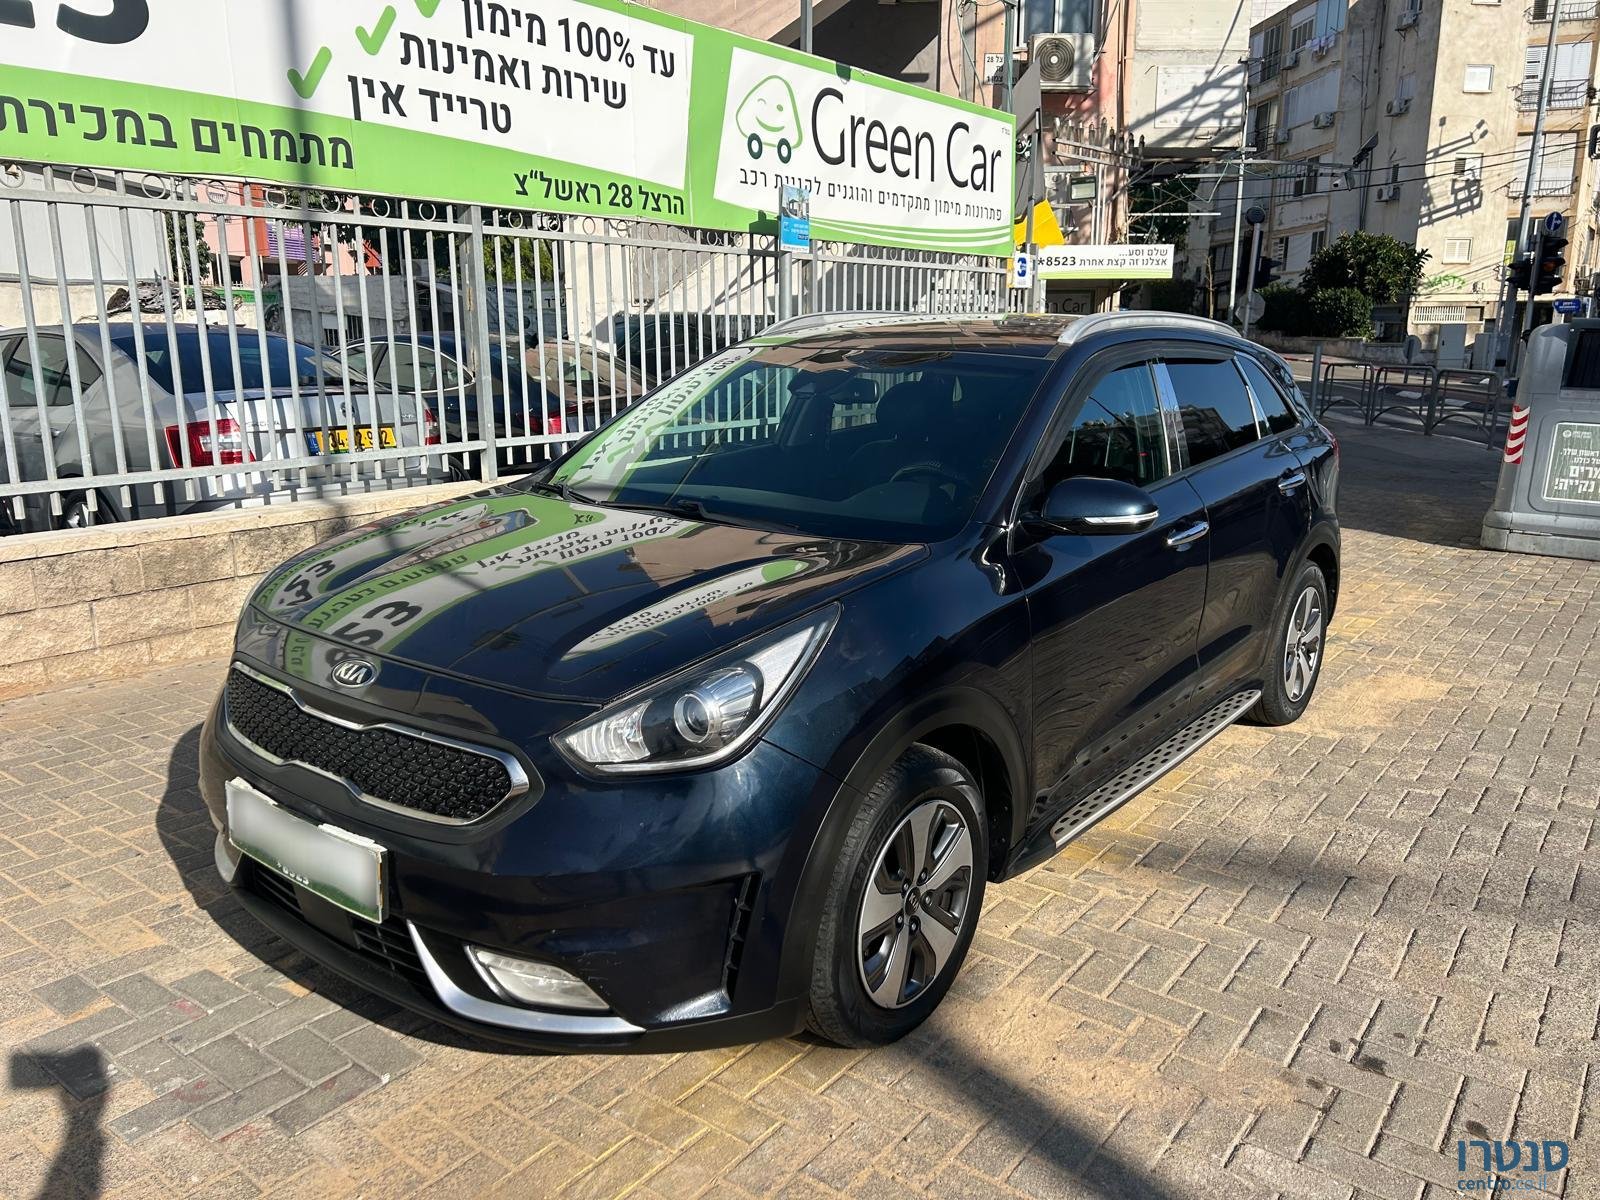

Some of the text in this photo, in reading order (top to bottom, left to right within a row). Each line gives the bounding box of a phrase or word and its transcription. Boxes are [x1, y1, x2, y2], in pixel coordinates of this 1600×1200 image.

[461, 0, 675, 78] עד 100% מימון
[400, 31, 627, 109] שירות ואמינות
[347, 75, 512, 134] טרייד אין
[0, 95, 354, 169] מתמחים במכירת
[811, 87, 1002, 193] Green Car
[740, 167, 767, 187] רכב
[607, 182, 633, 209] 28
[638, 185, 685, 215] הרצל
[828, 182, 873, 203] והוגנים
[878, 190, 930, 213] מתקדמים
[935, 199, 961, 216] מימון
[965, 203, 1002, 221] פתרונות
[1079, 258, 1104, 266] אחרת
[1106, 258, 1126, 267] קצת
[1128, 258, 1138, 266] זה
[1141, 257, 1167, 266] אצלנו
[1147, 248, 1168, 257] שלם
[1062, 297, 1088, 313] Car
[1553, 478, 1596, 493] נקייה!
[335, 662, 368, 684] KIA
